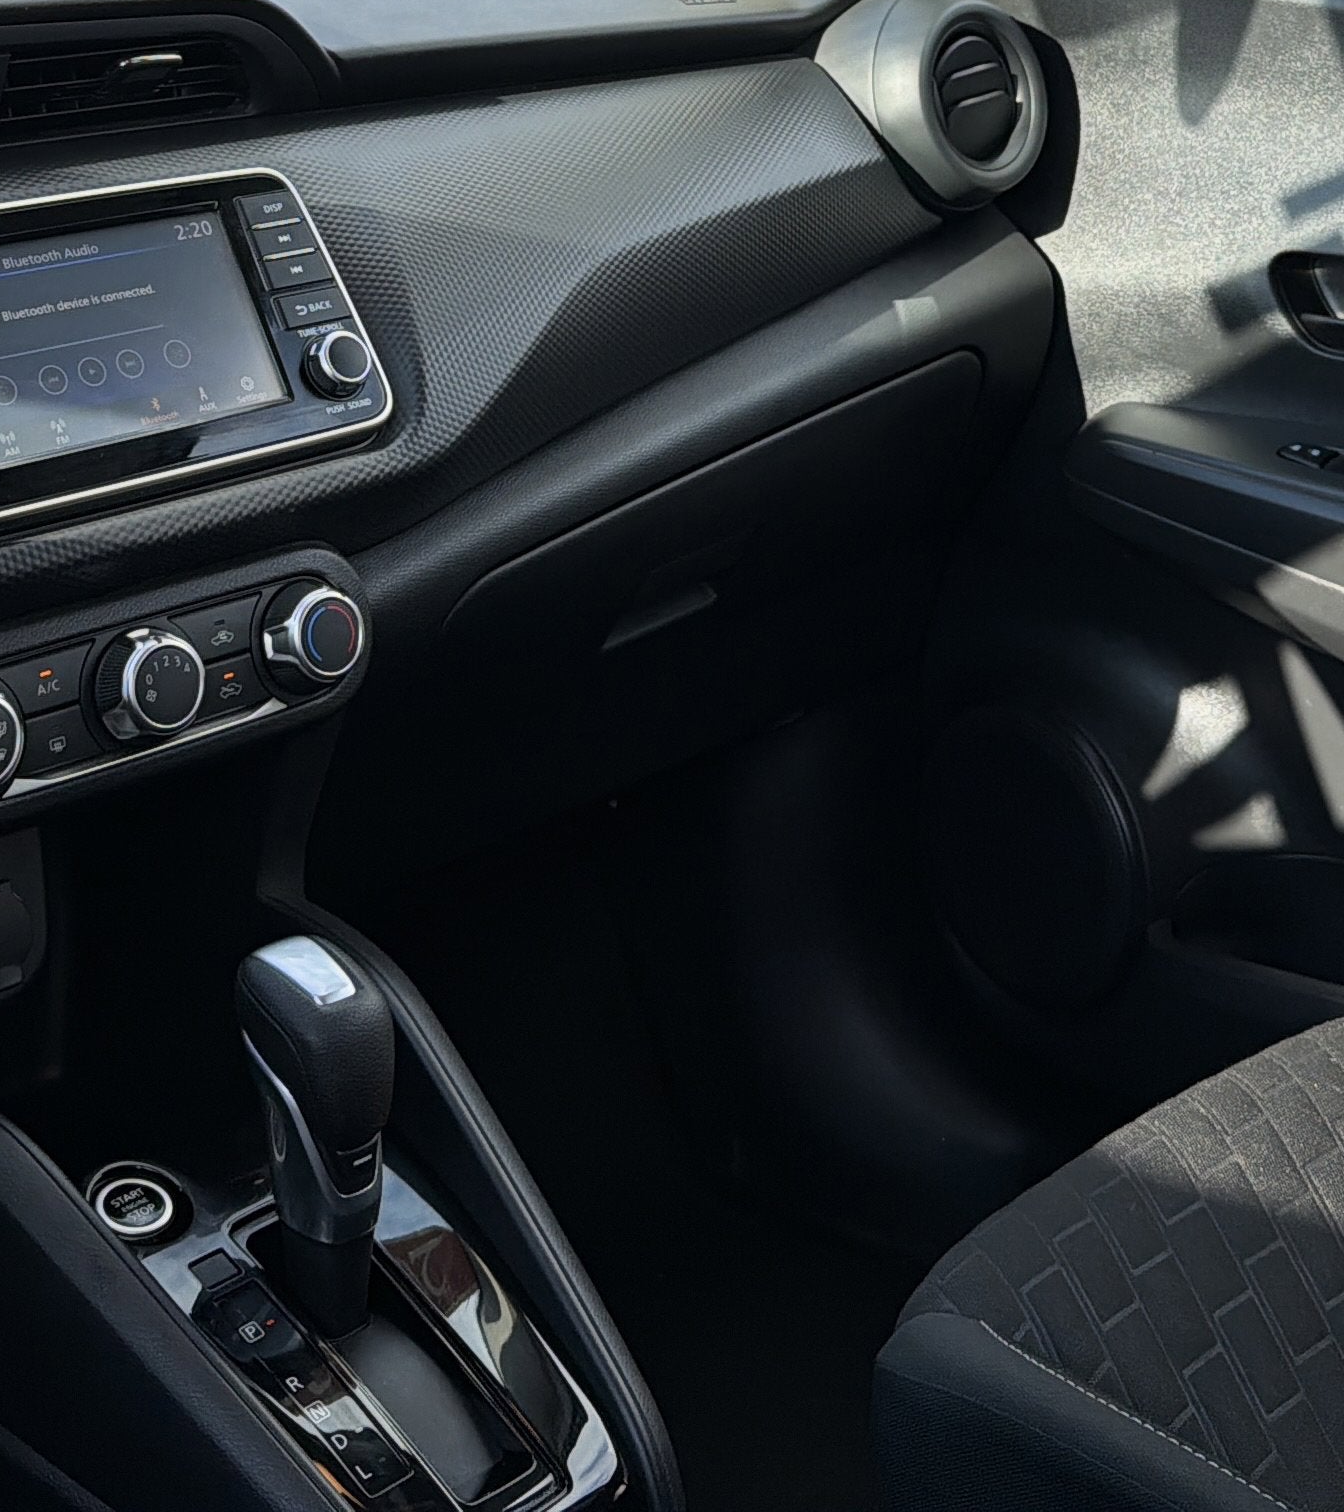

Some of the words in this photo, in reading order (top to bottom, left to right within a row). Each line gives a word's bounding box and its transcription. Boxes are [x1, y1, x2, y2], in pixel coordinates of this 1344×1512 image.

[262, 202, 284, 214] DISP
[173, 220, 214, 241] 2:20
[1, 247, 63, 270] Bluetooth
[64, 243, 99, 259] Audio
[2, 300, 56, 323] Bluetooth
[56, 296, 90, 313] device
[91, 294, 101, 306] is
[101, 284, 156, 304] connected.
[308, 300, 333, 313] BACK
[325, 404, 346, 416] PUSH
[347, 398, 373, 411] SOUND
[162, 655, 170, 667] 2
[173, 656, 181, 667] 3
[145, 673, 154, 686] 0
[37, 679, 61, 697] A/C
[110, 1187, 145, 1208] START
[244, 1325, 258, 1339] P
[285, 1376, 304, 1393] R
[309, 1405, 328, 1420] N
[330, 1433, 348, 1451] D
[355, 1465, 373, 1480] L
